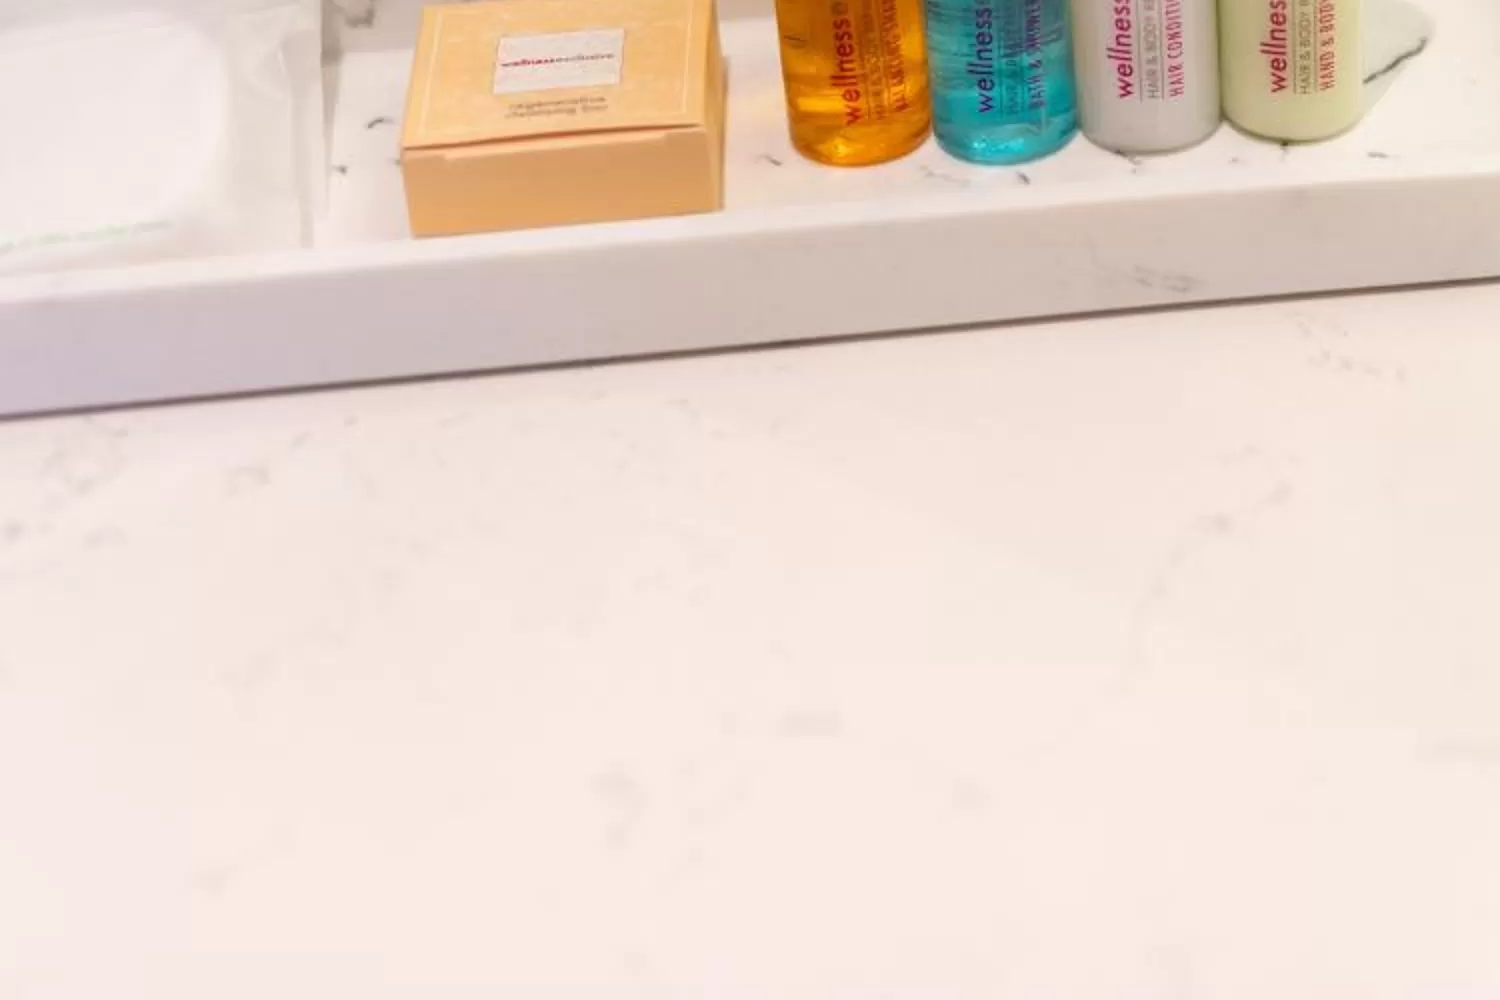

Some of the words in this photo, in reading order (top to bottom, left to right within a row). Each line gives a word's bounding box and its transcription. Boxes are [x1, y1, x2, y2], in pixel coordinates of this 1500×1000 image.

[1298, 12, 1311, 47] BODY
[1320, 37, 1335, 46] &
[1146, 69, 1160, 98] HAIR
[1168, 64, 1185, 97] HAIR
[1299, 63, 1311, 95] HAIR
[1319, 52, 1336, 91] HAND
